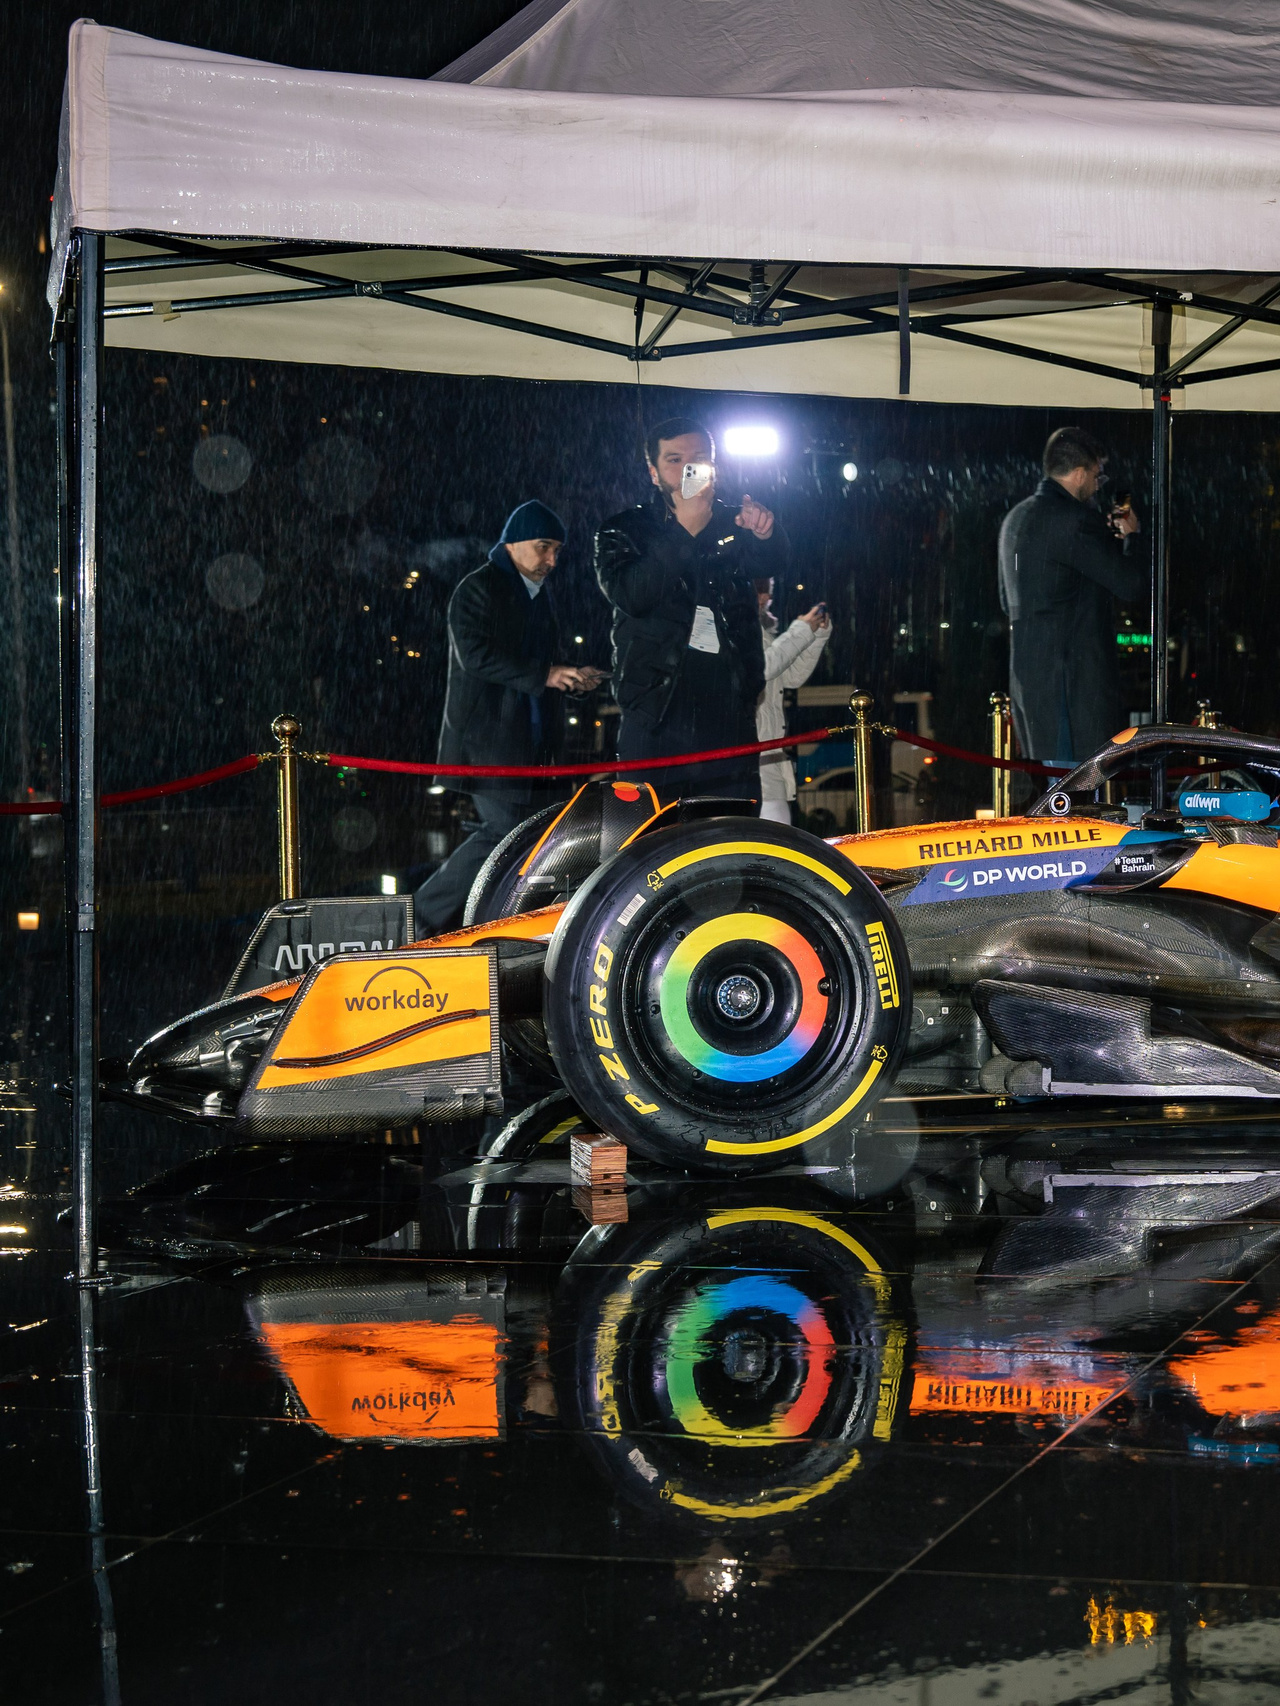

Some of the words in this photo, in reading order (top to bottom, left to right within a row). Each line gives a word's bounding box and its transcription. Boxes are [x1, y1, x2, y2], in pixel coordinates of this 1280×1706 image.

[1185, 794, 1220, 812] allwyn
[919, 834, 1023, 860] RICHARD
[1032, 828, 1103, 848] MILLE
[972, 867, 1003, 886] DP
[1006, 860, 1087, 882] WORLD
[1114, 856, 1145, 866] #Team
[1121, 862, 1156, 873] Bahrain
[865, 921, 900, 1010] PIRELLI
[344, 988, 449, 1012] workday
[589, 942, 631, 1081] ZERO
[624, 1093, 660, 1115] P
